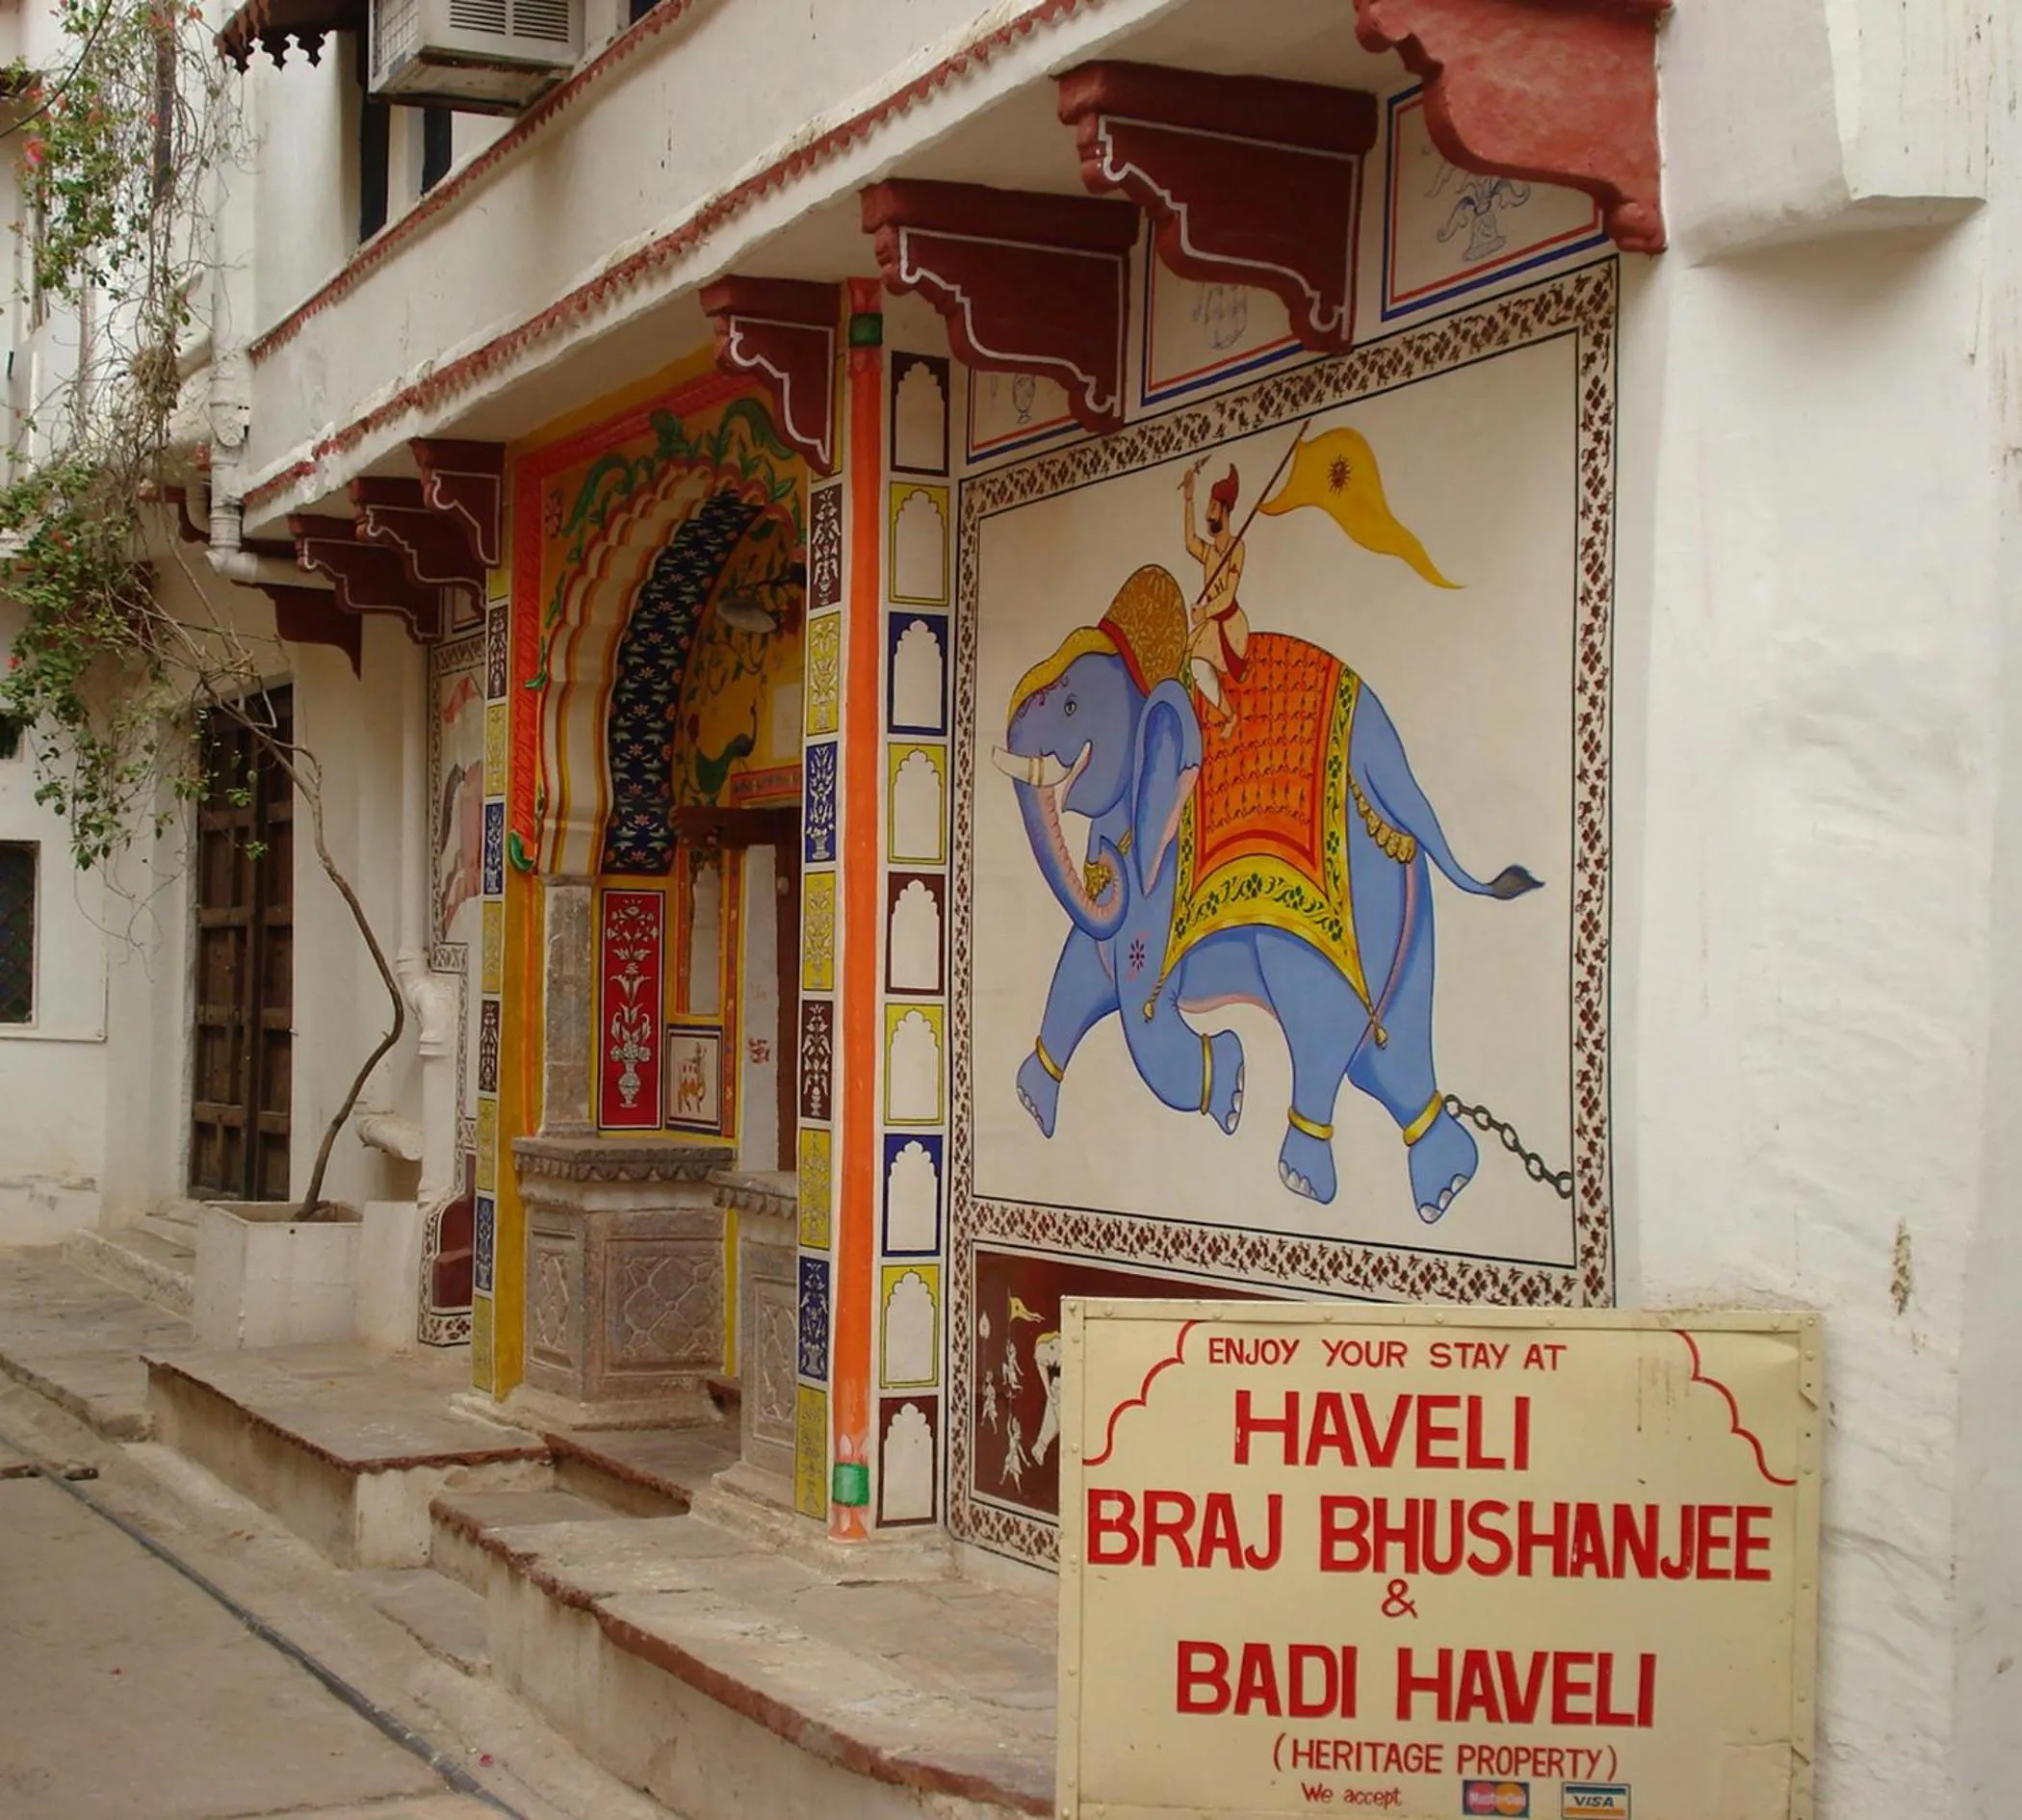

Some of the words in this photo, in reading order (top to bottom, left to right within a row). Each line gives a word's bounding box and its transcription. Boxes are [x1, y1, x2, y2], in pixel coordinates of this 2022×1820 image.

[1207, 1335, 1301, 1367] ENJOY
[1320, 1338, 1410, 1369] YOUR
[1427, 1339, 1510, 1370] STAY
[1521, 1341, 1569, 1371] AT
[1231, 1388, 1532, 1472] HAVELI
[1085, 1486, 1285, 1572] BRAJ
[1317, 1493, 1775, 1582] BHUSHANJEE
[1379, 1576, 1419, 1620] &
[1174, 1638, 1360, 1722] BADI
[1393, 1644, 1658, 1729] HAVELI
[1271, 1732, 1445, 1776] (HERITAGE
[1456, 1742, 1620, 1781] PROPERTY)
[1300, 1781, 1335, 1804] We
[1342, 1786, 1403, 1808] accept
[1573, 1795, 1616, 1808] VISA
